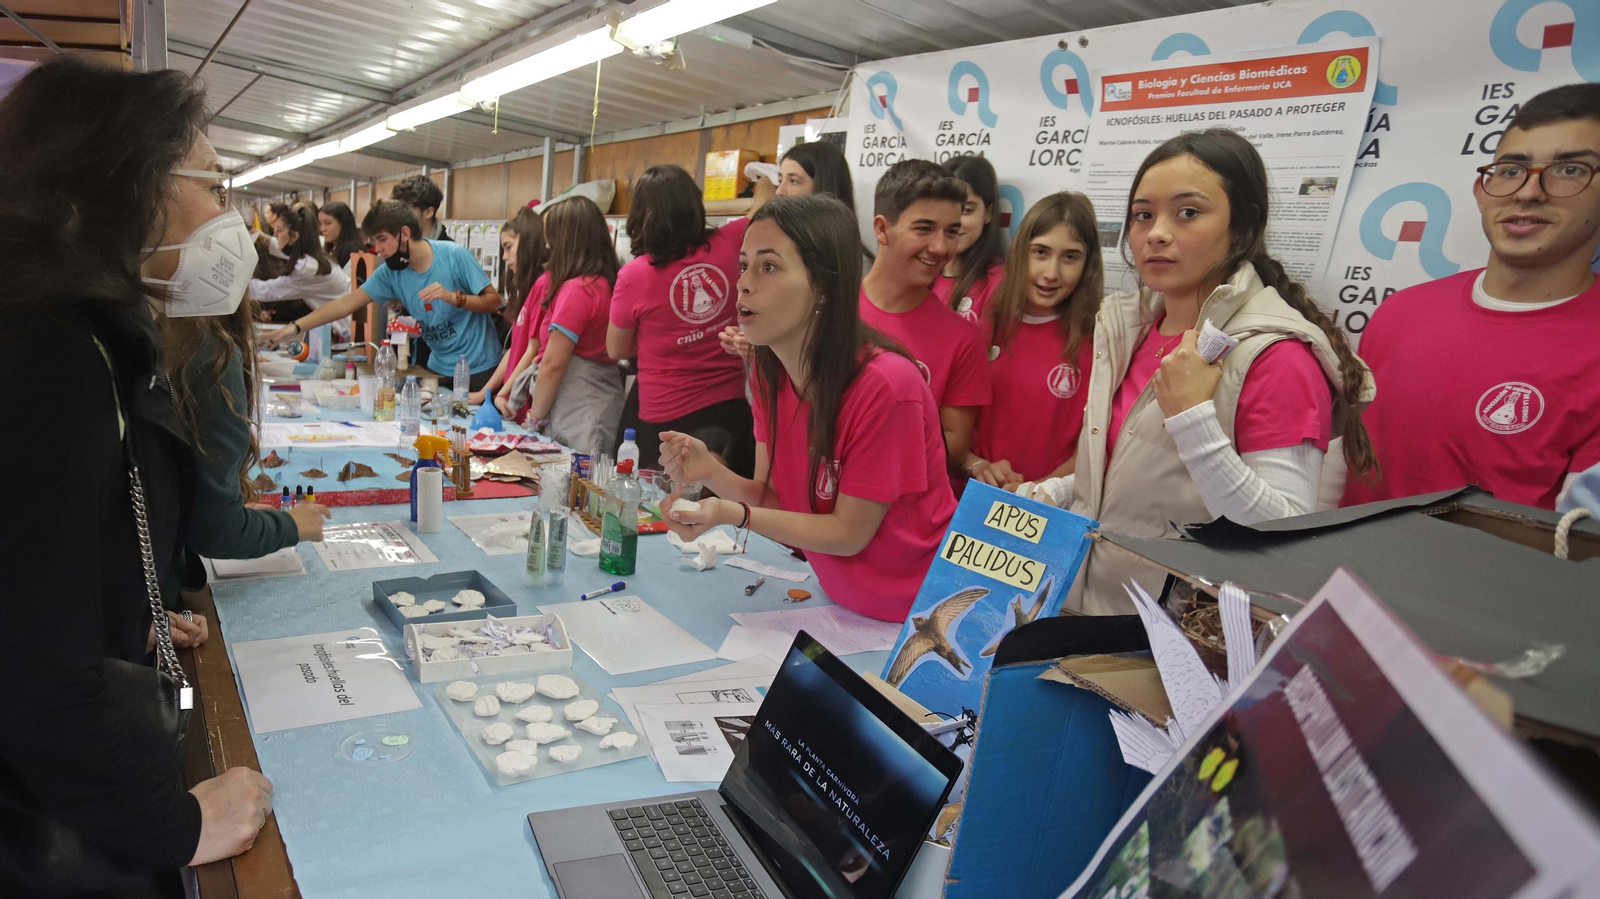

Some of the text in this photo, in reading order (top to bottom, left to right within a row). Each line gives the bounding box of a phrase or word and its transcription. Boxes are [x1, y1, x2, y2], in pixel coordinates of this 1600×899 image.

[1138, 77, 1178, 89] Biología
[1180, 77, 1188, 87] y
[1239, 65, 1308, 80] Biomédicas
[1147, 92, 1176, 100] Premios
[1177, 87, 1210, 97] Facultad
[1224, 82, 1270, 93] Enfermería
[1272, 80, 1292, 89] UCA
[1481, 81, 1516, 101] IES
[1038, 116, 1056, 127] IES
[1106, 102, 1346, 127] ICNOFÓSILES: HUELLAS DEL PASADO A PROTEGER
[863, 124, 876, 134] IES
[938, 120, 954, 131] IES
[862, 131, 908, 149] GARCÍA
[935, 128, 991, 147] GARCÍA
[1035, 126, 1090, 145] GARCÍ
[1028, 149, 1083, 167] LORC
[1344, 265, 1372, 281] IES
[421, 321, 455, 334] ARCÍA
[425, 327, 457, 342] ORCA
[987, 503, 1040, 539] APUS
[295, 663, 319, 684] pasado
[336, 694, 355, 706] del
[797, 738, 860, 806] LA PLANTA CARNÍVORA
[764, 719, 891, 861] MÁS RARA DE LA NATURALEZA
